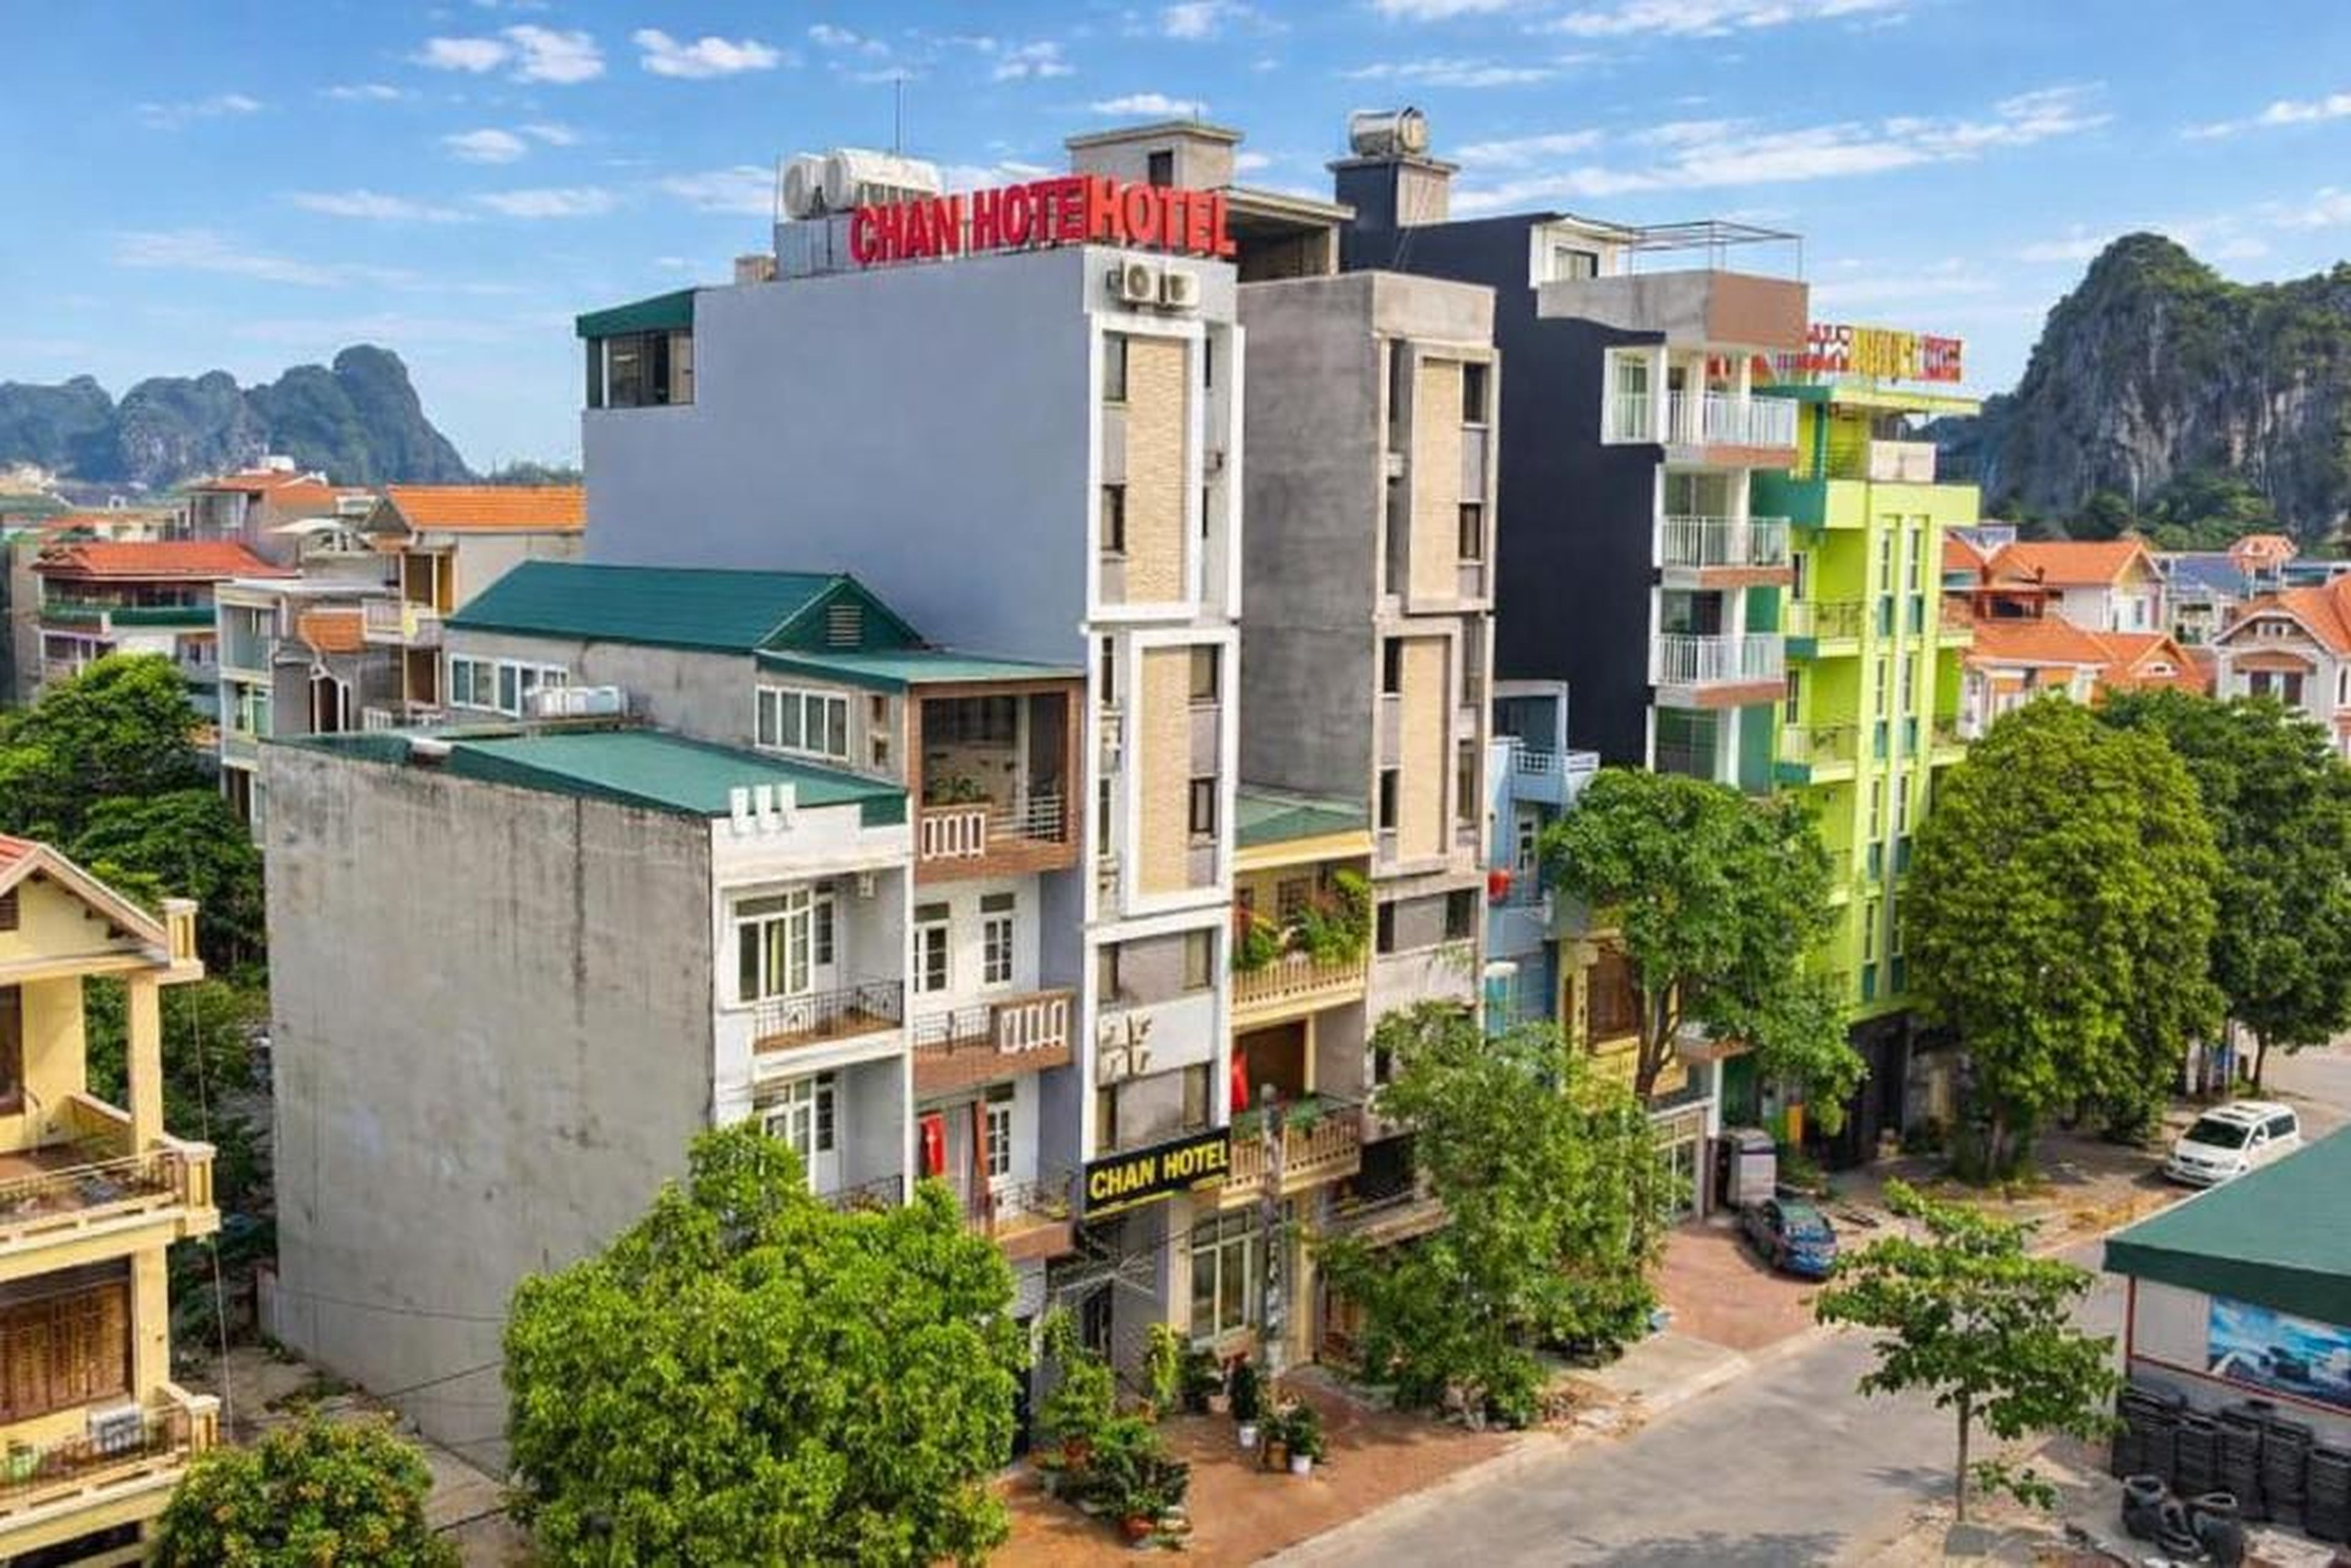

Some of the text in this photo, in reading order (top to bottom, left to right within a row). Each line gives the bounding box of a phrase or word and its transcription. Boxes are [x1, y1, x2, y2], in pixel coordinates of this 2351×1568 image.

[850, 195, 964, 264] CHAN
[1088, 172, 1236, 256] HOTEL
[1090, 1139, 1228, 1200] CHAN HOTEL
